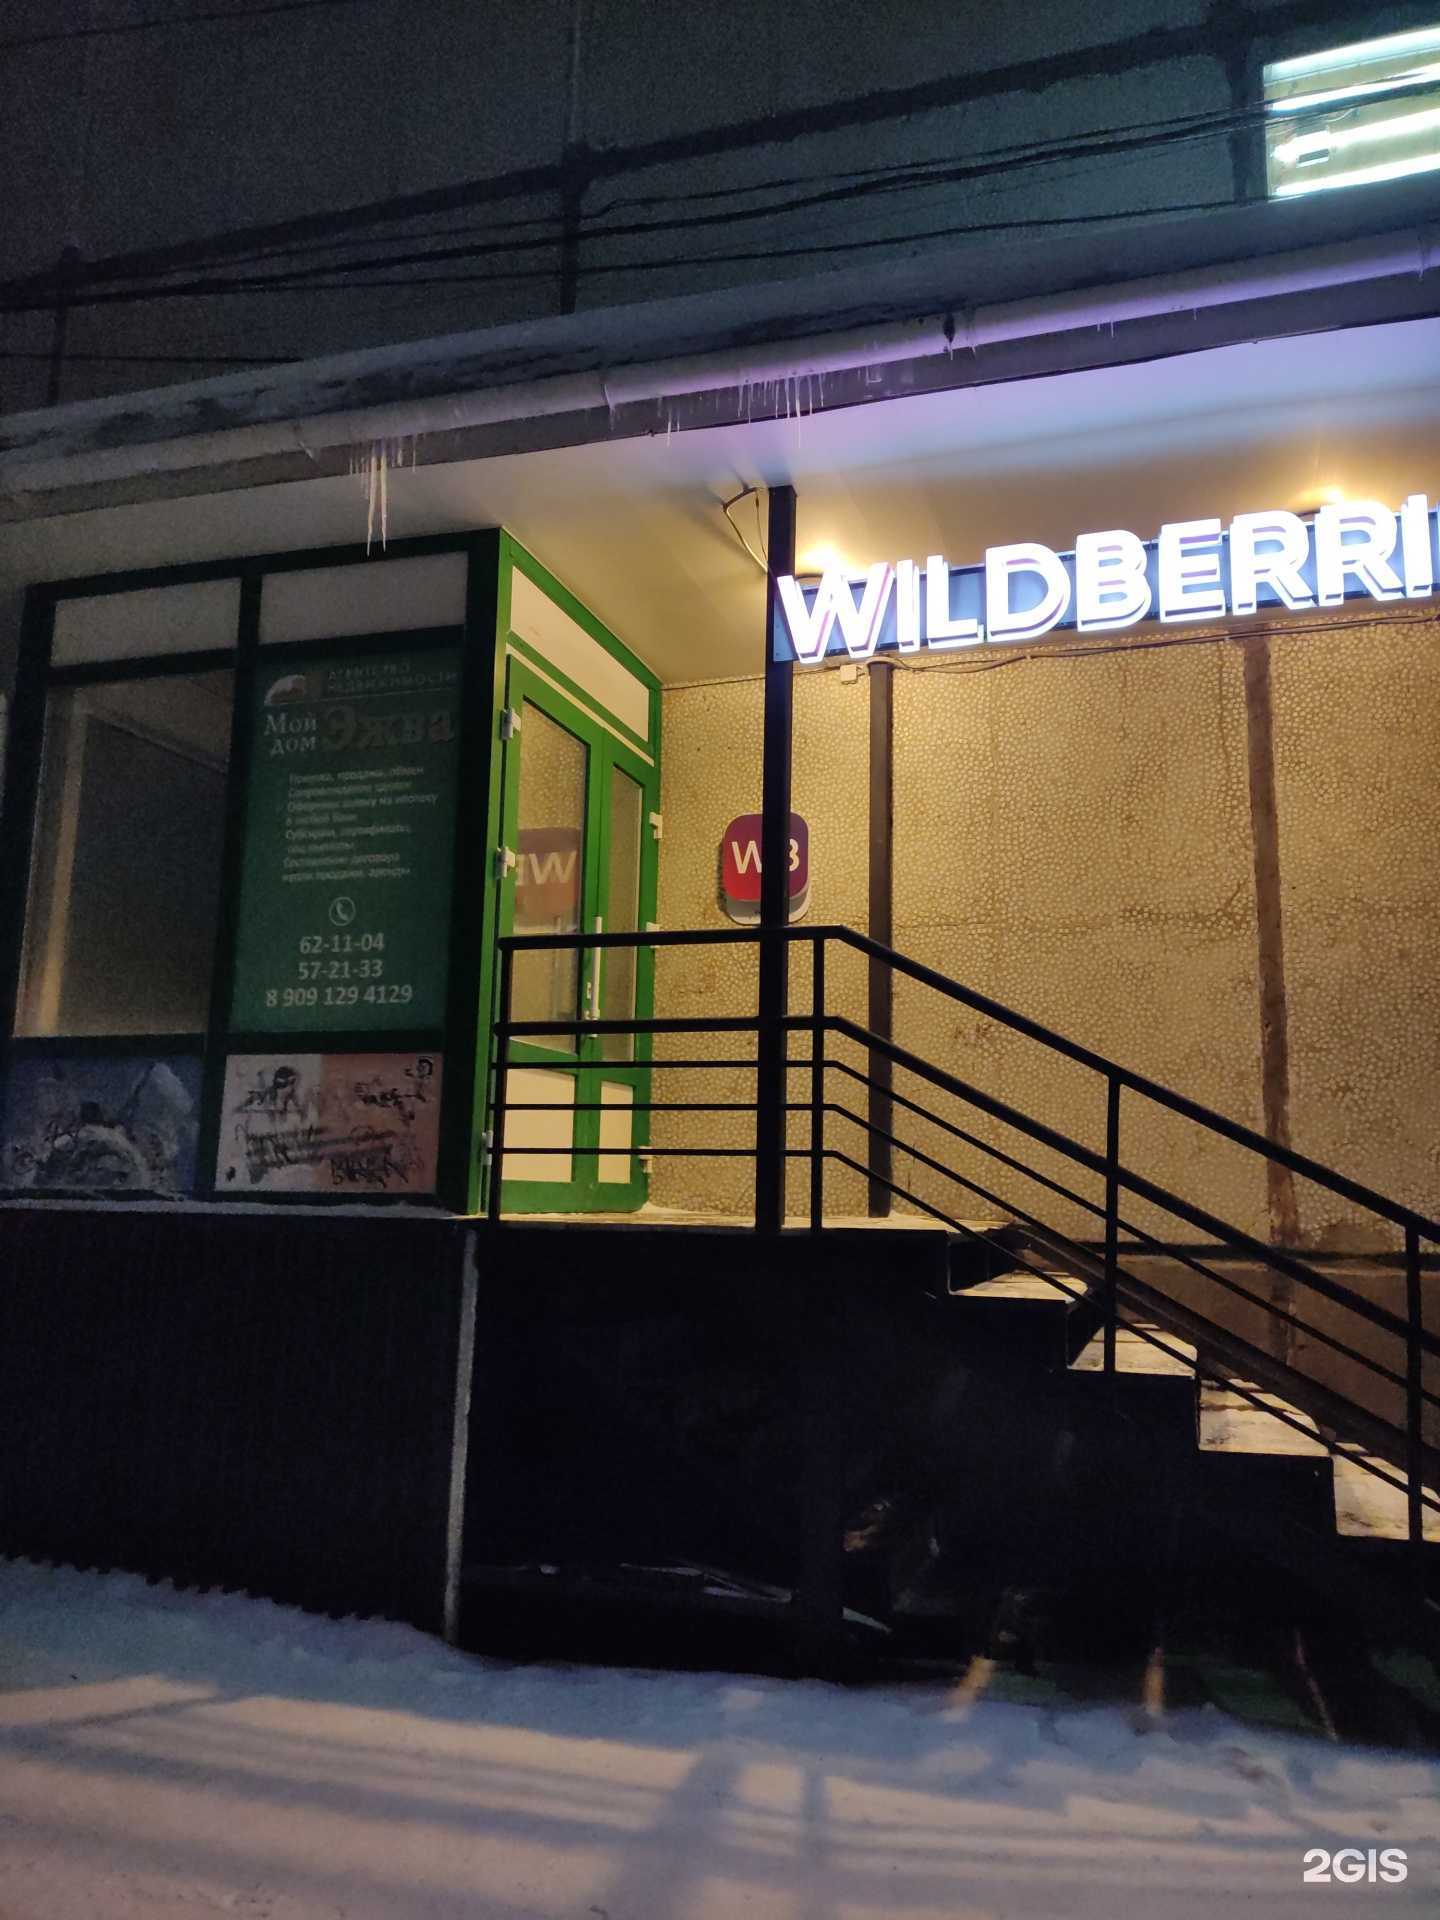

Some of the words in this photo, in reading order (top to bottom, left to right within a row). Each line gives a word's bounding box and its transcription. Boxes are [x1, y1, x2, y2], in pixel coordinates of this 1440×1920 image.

[264, 711, 318, 736] Мой
[269, 736, 317, 757] дом
[299, 932, 385, 954] 62-11-04
[297, 959, 384, 981] 57-21-33
[265, 989, 278, 1008] 8
[282, 987, 318, 1007] 909
[323, 986, 358, 1005] 129
[363, 984, 413, 1004] 4129
